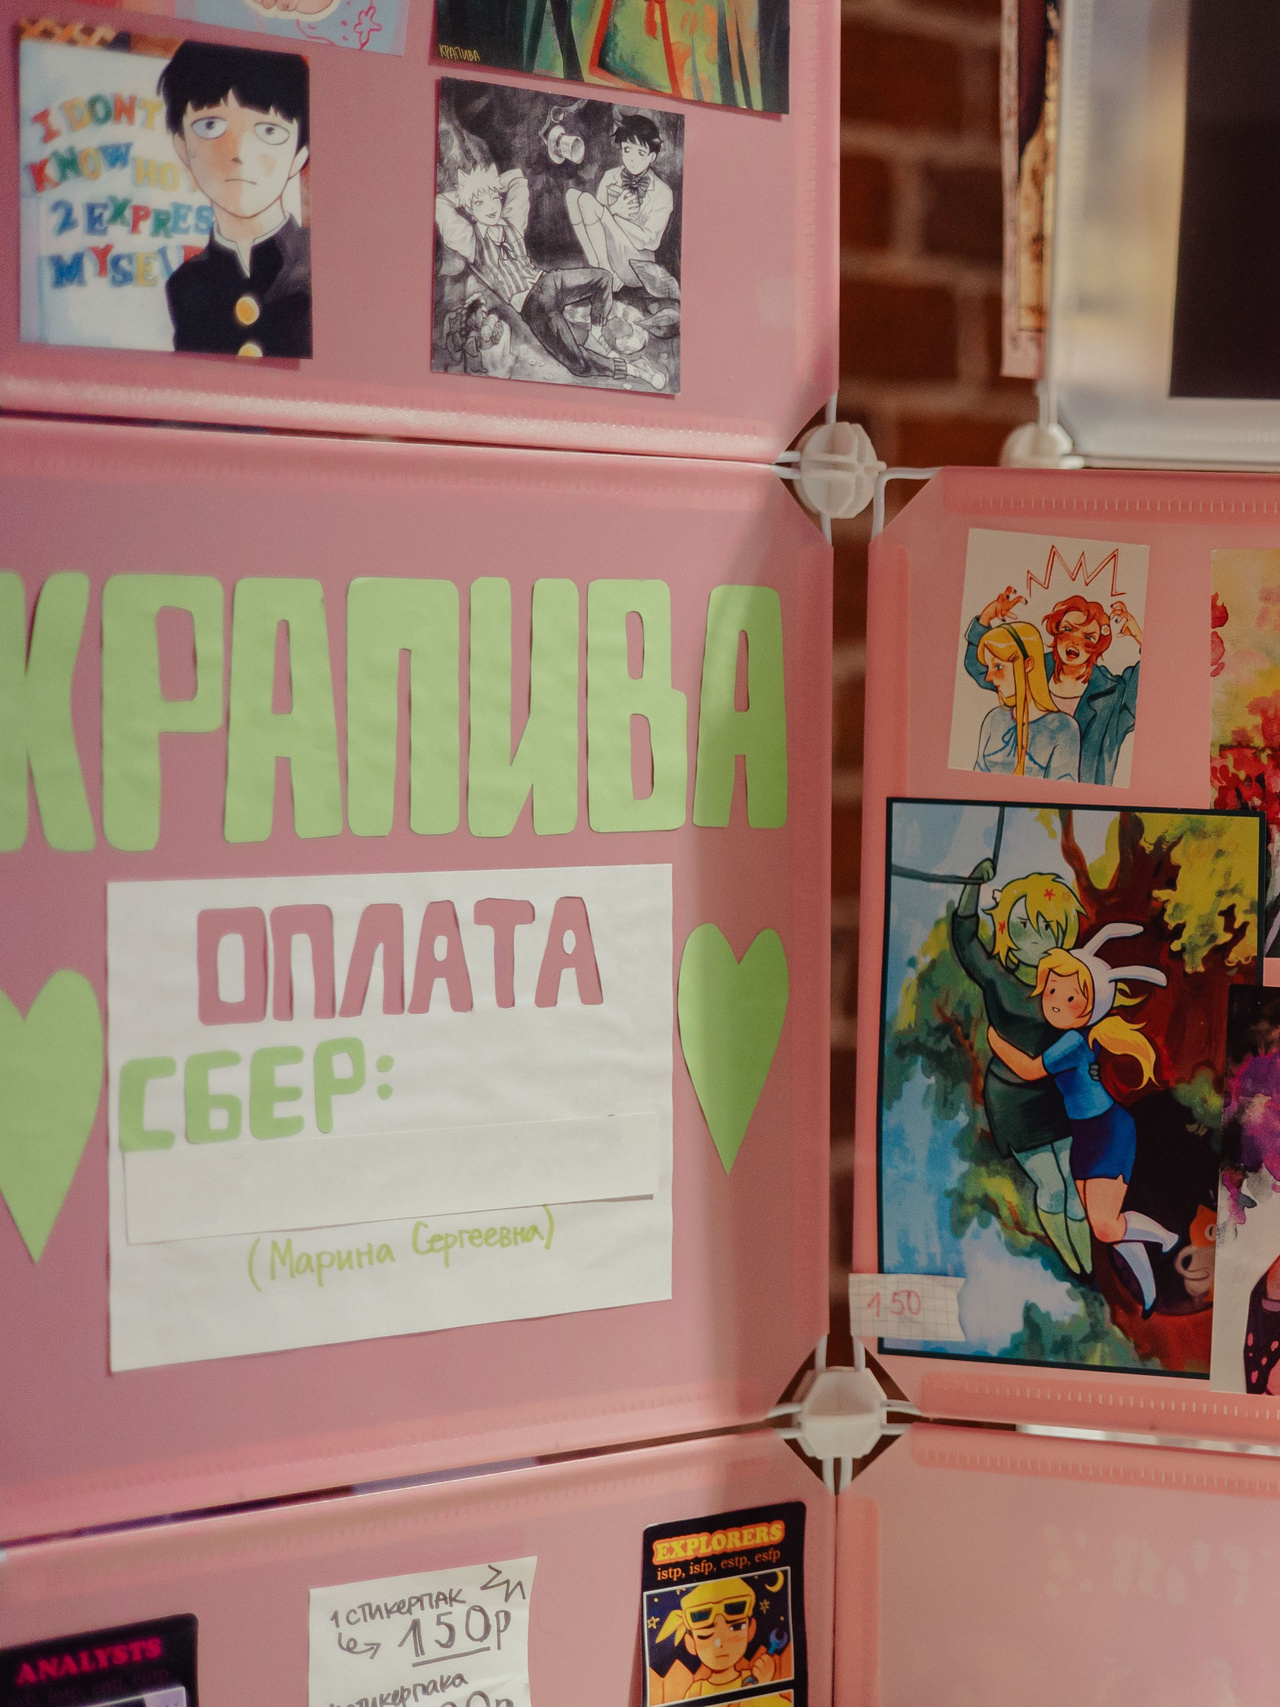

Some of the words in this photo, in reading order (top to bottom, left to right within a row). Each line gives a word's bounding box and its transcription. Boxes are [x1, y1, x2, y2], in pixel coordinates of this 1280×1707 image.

[32, 109, 61, 144] I
[62, 93, 163, 131] DONT
[28, 142, 133, 193] KNOW
[133, 156, 199, 193] HO
[51, 199, 78, 236] 2
[0, 571, 788, 852] КРАПИВА
[197, 896, 604, 1026] ОПЛАТА
[119, 1037, 395, 1152] СБЕР:
[247, 1236, 396, 1292] (Марина
[412, 1203, 554, 1268] Сергеевна)
[867, 1289, 922, 1317] 150
[654, 1522, 784, 1562] EXPLORERS
[656, 1566, 686, 1582] istp,
[689, 1560, 717, 1576] isfp,
[720, 1554, 751, 1570] estp,
[754, 1548, 781, 1563] esfp
[16, 1636, 163, 1686] ANALYSTS
